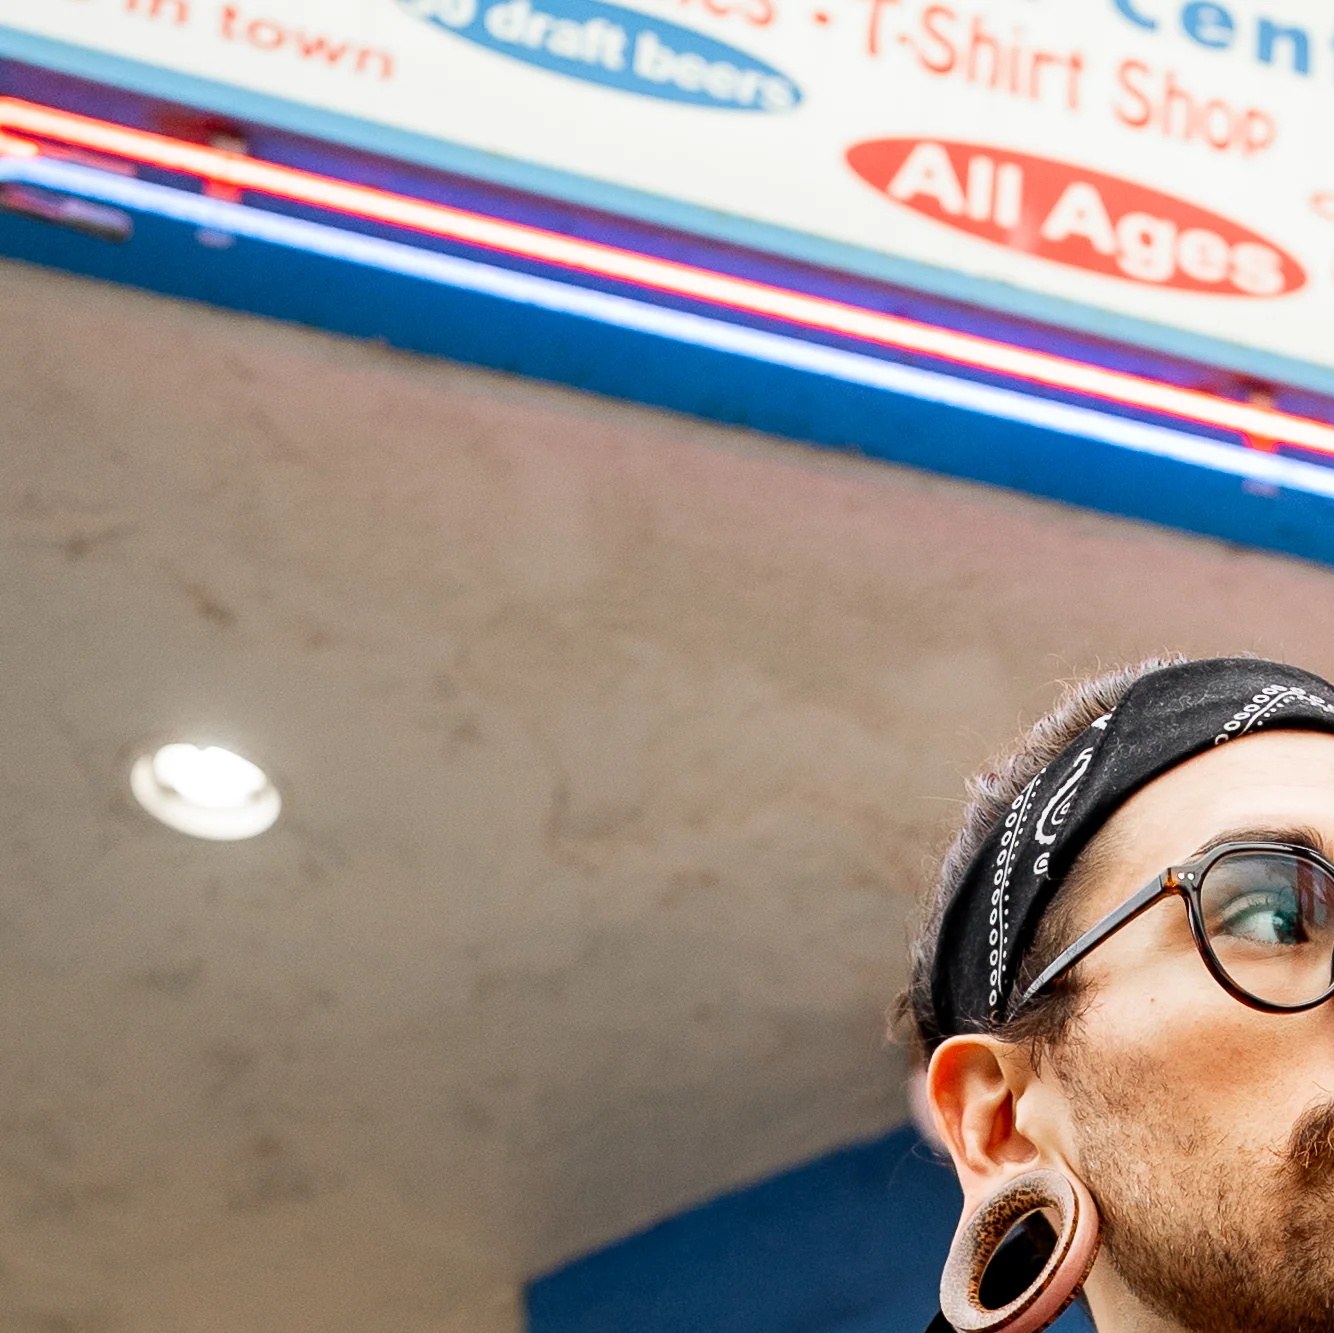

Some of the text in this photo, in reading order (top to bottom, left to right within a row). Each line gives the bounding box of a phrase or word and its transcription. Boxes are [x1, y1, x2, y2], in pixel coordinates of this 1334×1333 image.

[220, 2, 395, 81] town
[484, 0, 796, 111] draft beers
[858, 0, 1278, 157] T-Shirt Shop
[886, 141, 1286, 296] All Ages
